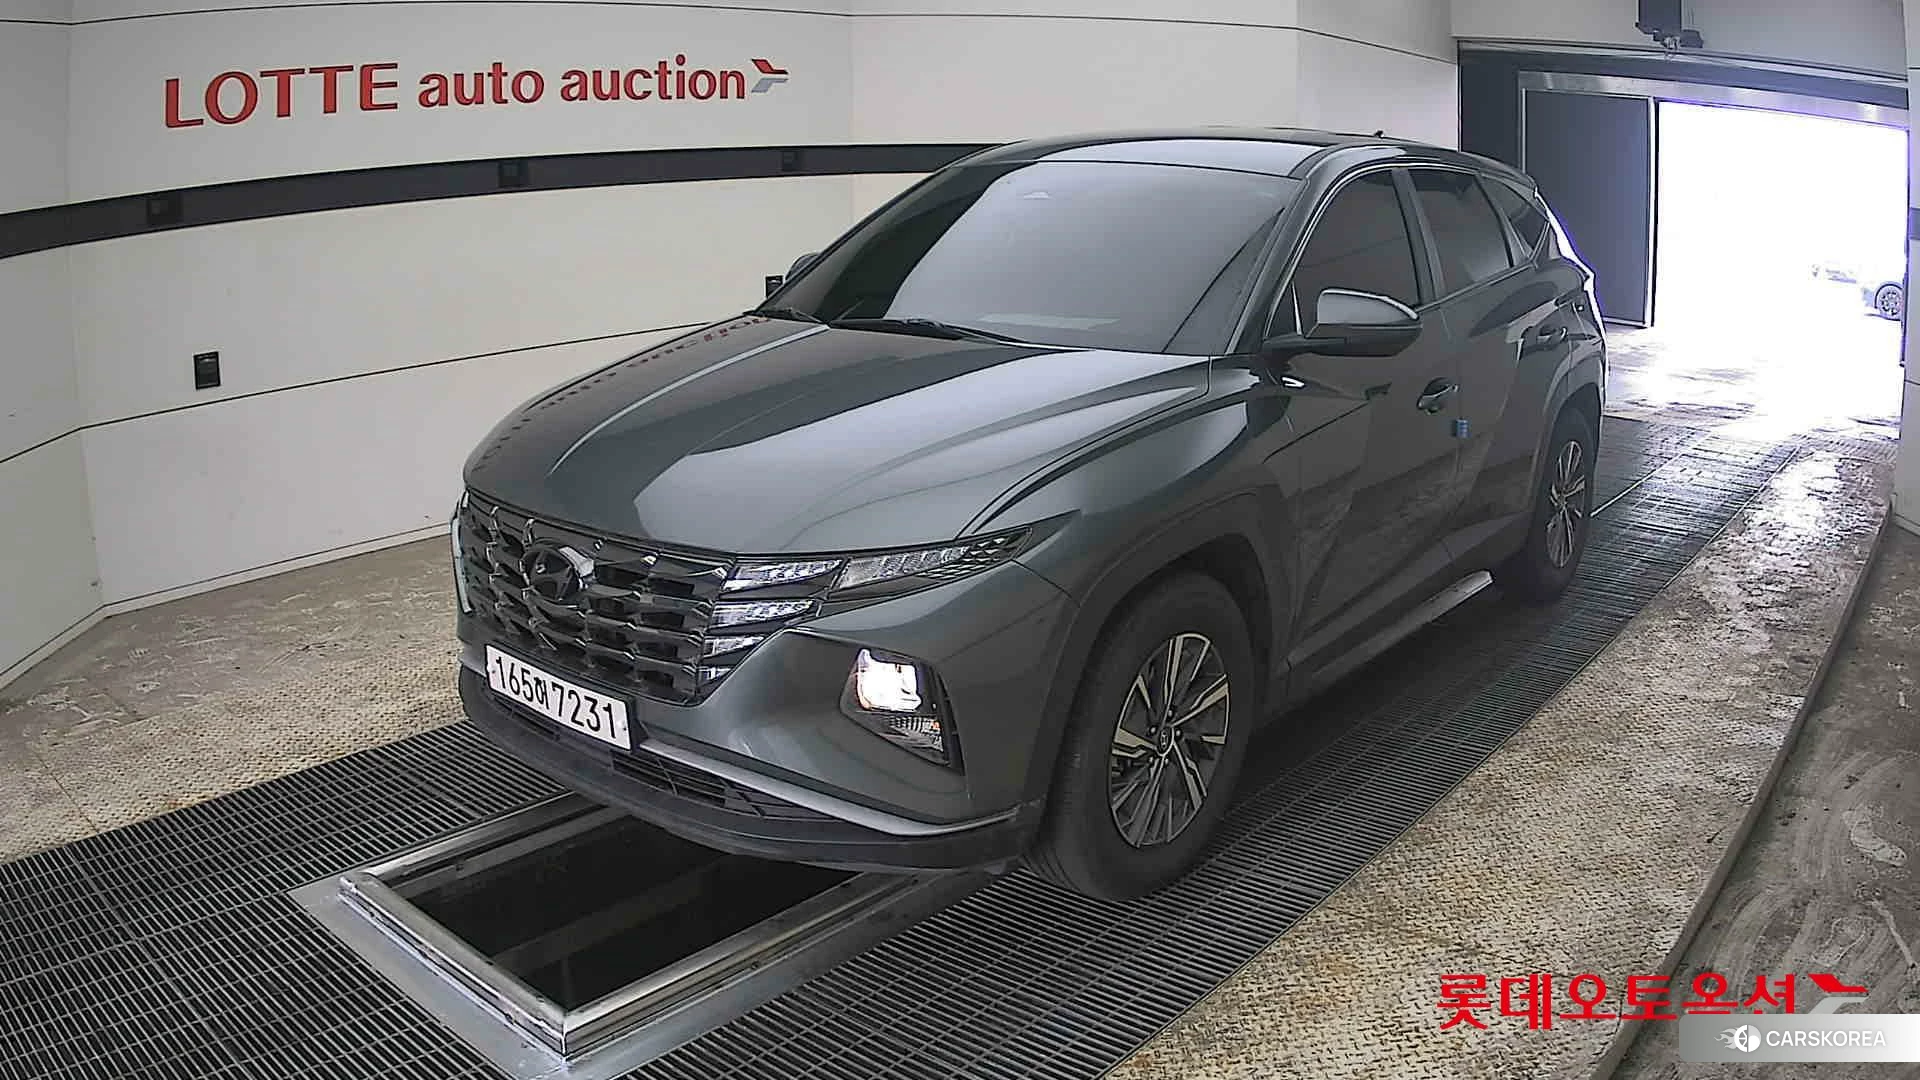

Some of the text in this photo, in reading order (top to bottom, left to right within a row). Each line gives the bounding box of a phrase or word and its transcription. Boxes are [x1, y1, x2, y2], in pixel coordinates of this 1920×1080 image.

[164, 53, 747, 129] LOTTE auto auction
